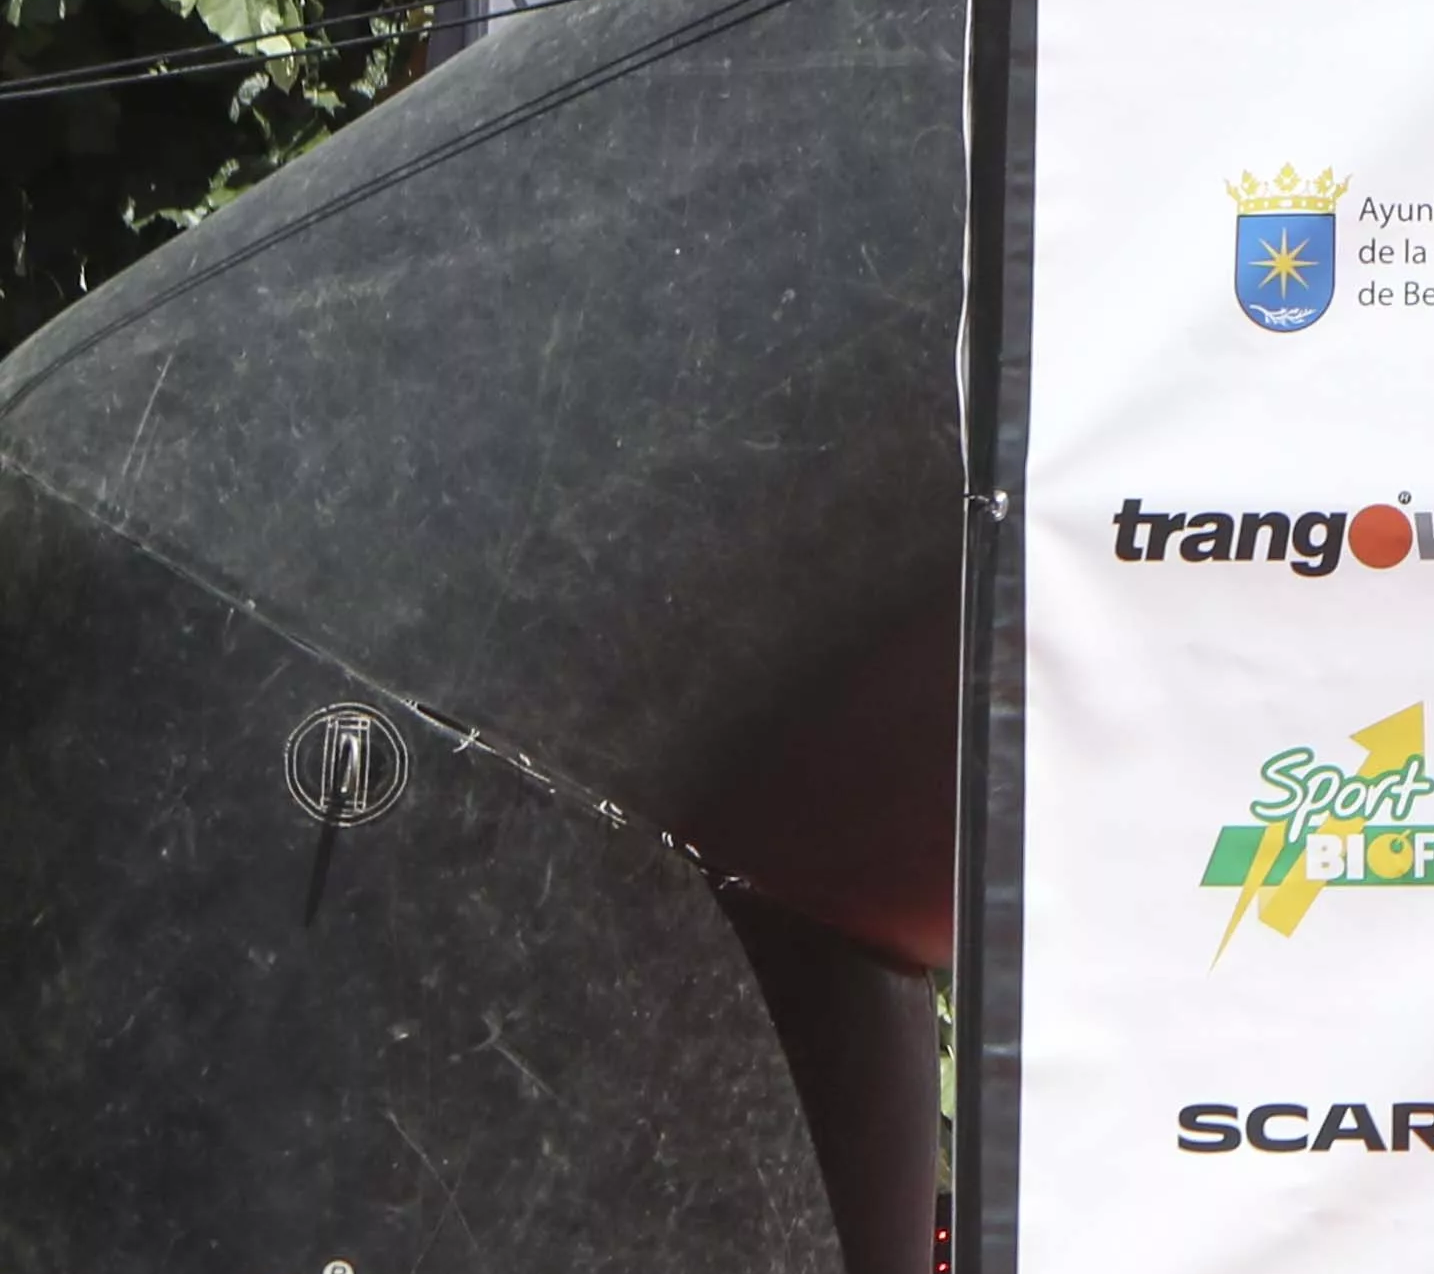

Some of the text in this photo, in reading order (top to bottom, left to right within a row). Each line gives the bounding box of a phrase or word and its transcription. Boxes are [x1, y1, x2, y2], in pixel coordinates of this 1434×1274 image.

[1358, 239, 1395, 265] de
[1404, 239, 1428, 265] la
[1358, 282, 1395, 308] de
